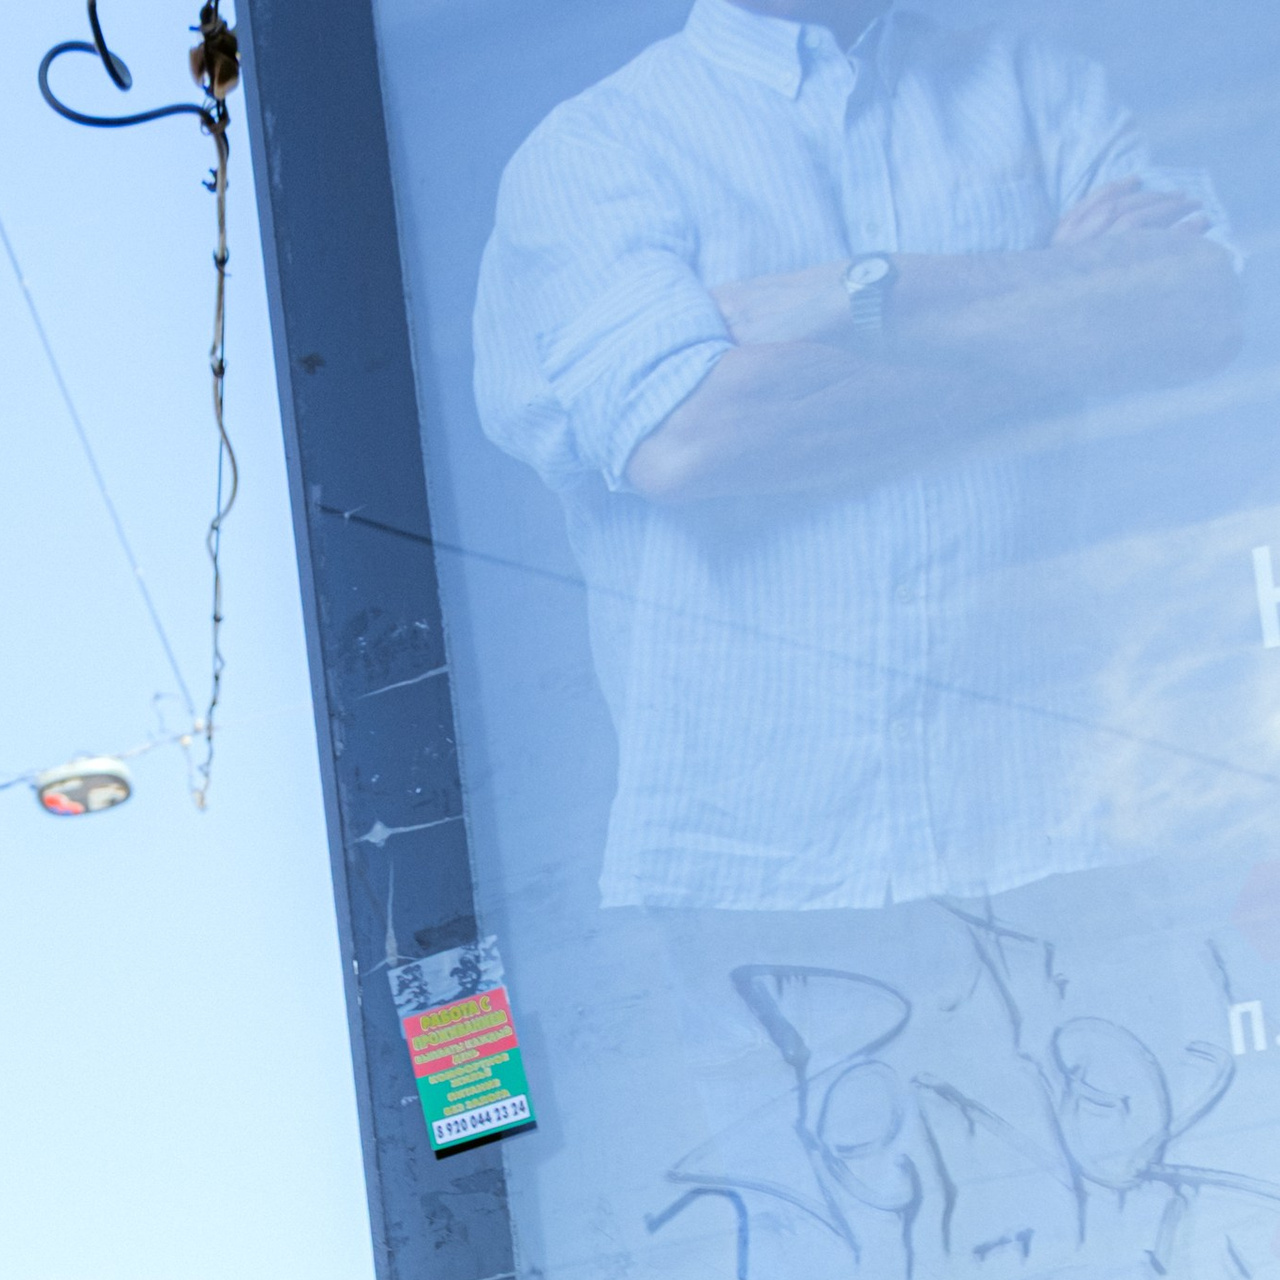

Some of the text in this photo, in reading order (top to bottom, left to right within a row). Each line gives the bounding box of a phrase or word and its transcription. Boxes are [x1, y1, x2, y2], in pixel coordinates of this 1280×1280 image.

[420, 995, 491, 1030] РАБОТА С
[446, 1118, 468, 1135] 920
[470, 1111, 492, 1128] 044
[494, 1105, 509, 1121] 23
[511, 1100, 527, 1115] 24
